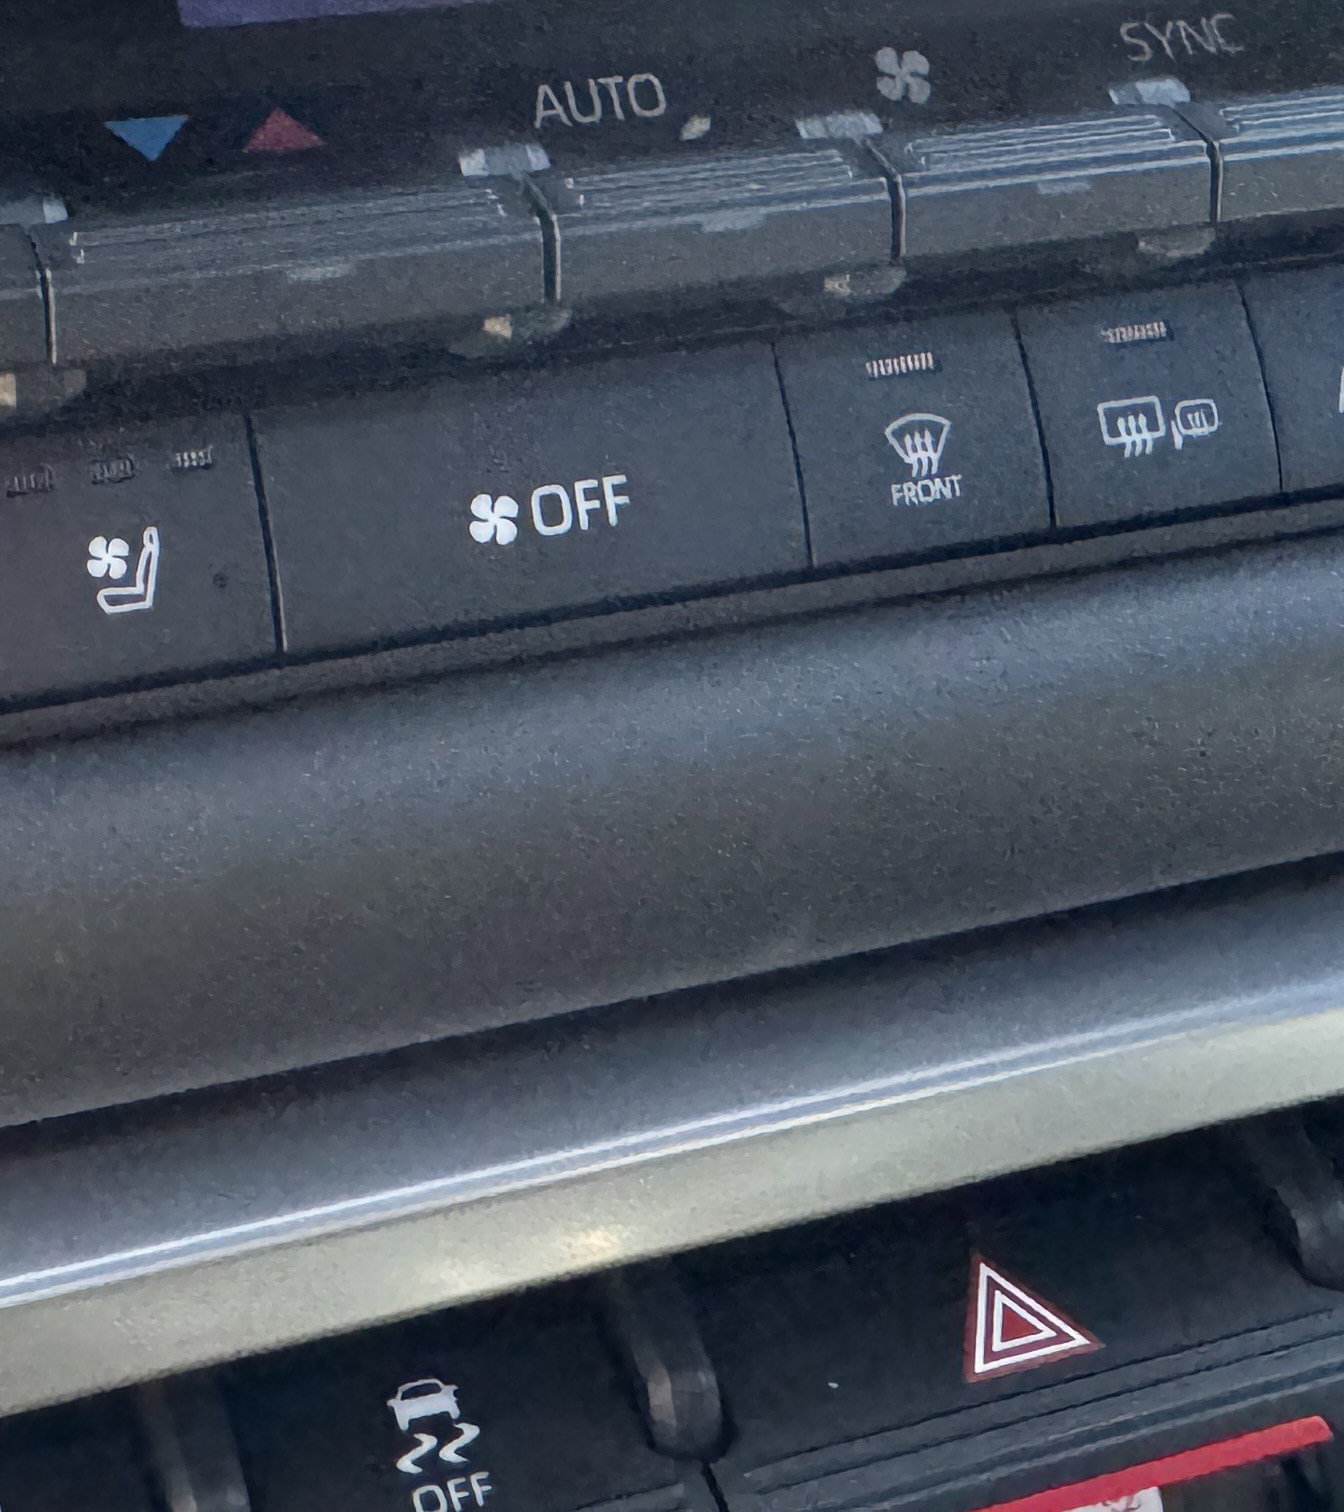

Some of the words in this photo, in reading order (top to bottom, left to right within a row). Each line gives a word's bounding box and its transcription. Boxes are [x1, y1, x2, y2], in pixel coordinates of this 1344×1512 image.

[1119, 13, 1243, 61] SYNC
[533, 73, 666, 129] AUTO
[531, 474, 630, 536] OFF
[891, 474, 962, 506] FRONT
[412, 1471, 492, 1512] OFF
